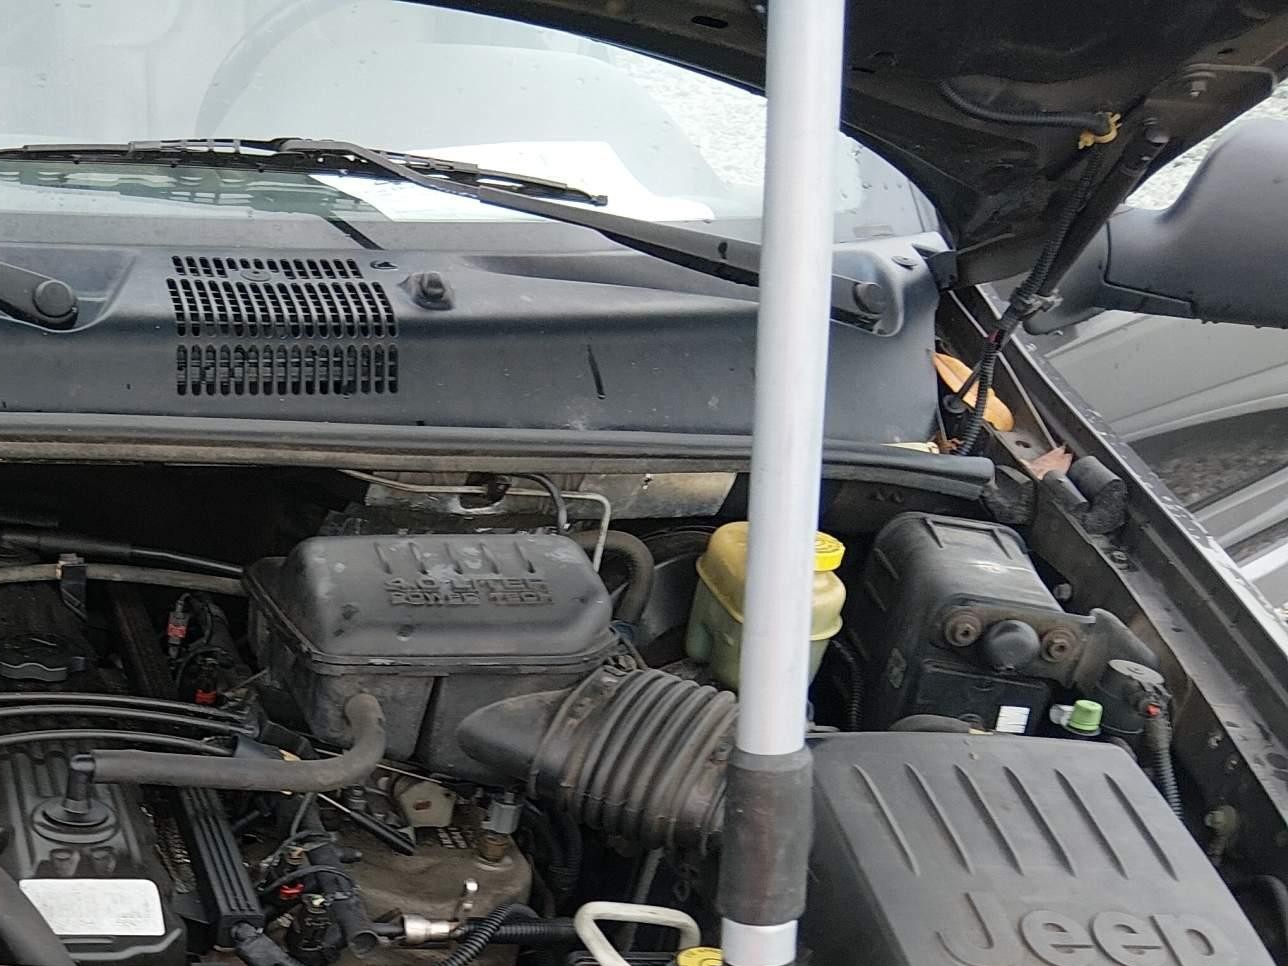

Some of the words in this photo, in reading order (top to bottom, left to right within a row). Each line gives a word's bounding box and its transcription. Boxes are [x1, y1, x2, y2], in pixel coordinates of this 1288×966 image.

[384, 576, 441, 592] 4.0
[450, 576, 550, 593] LITER
[389, 591, 481, 606] POWER
[487, 591, 554, 607] TECH
